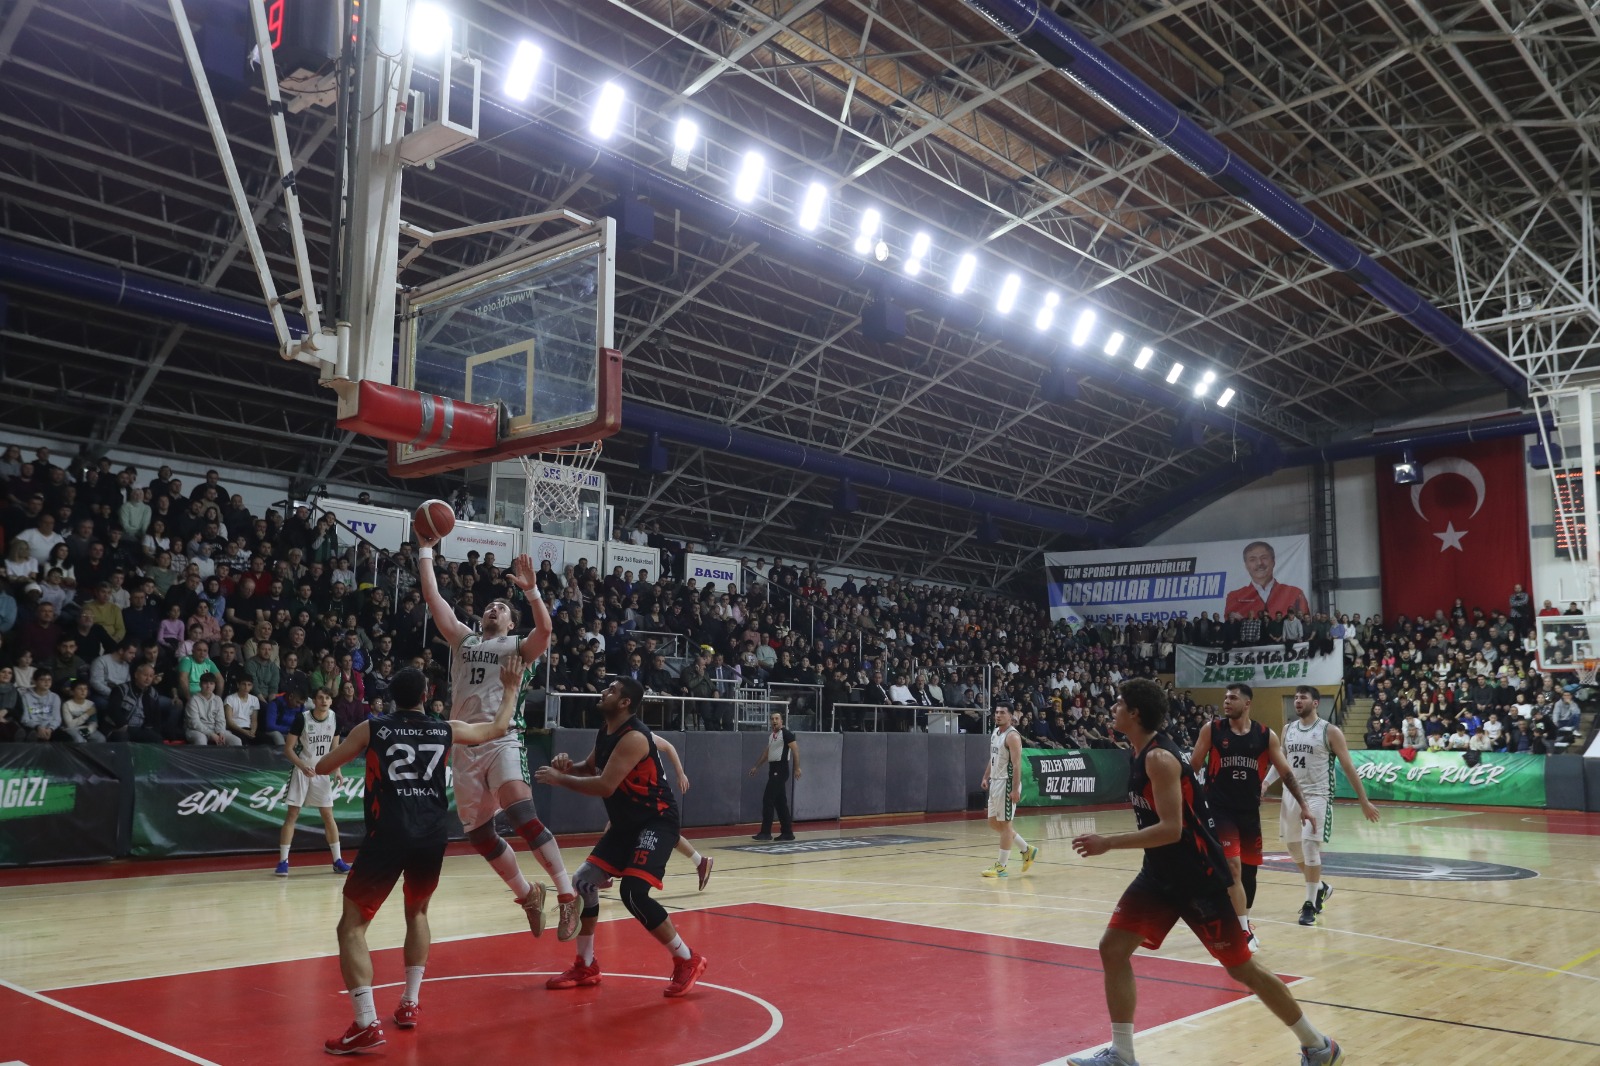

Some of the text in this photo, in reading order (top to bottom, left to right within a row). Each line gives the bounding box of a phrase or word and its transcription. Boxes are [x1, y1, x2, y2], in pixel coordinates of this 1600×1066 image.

[543, 467, 561, 480] SES
[347, 520, 377, 534] TV
[694, 567, 734, 581] BASIN
[1064, 560, 1192, 579] TÜM SPORCU VE ANTRENÖRLERE
[1062, 574, 1222, 606] BAŞARILAR DİLERİM
[1082, 610, 1189, 624] YUSUF ALEMDAR
[462, 650, 499, 665] SAKARYA
[1204, 652, 1230, 667] BU
[469, 667, 486, 685] 13
[1202, 665, 1256, 683] ZAFER
[308, 734, 332, 744] SAKARYA
[394, 728, 424, 737] YILDIZ
[316, 745, 325, 757] 10
[1287, 743, 1314, 754] SAKARYA
[385, 743, 445, 781] 27
[1292, 755, 1306, 769] 24
[1232, 770, 1247, 780] 23
[1356, 762, 1506, 786] BOYS OF RIVER
[177, 787, 240, 816] SON
[633, 850, 650, 865] 15
